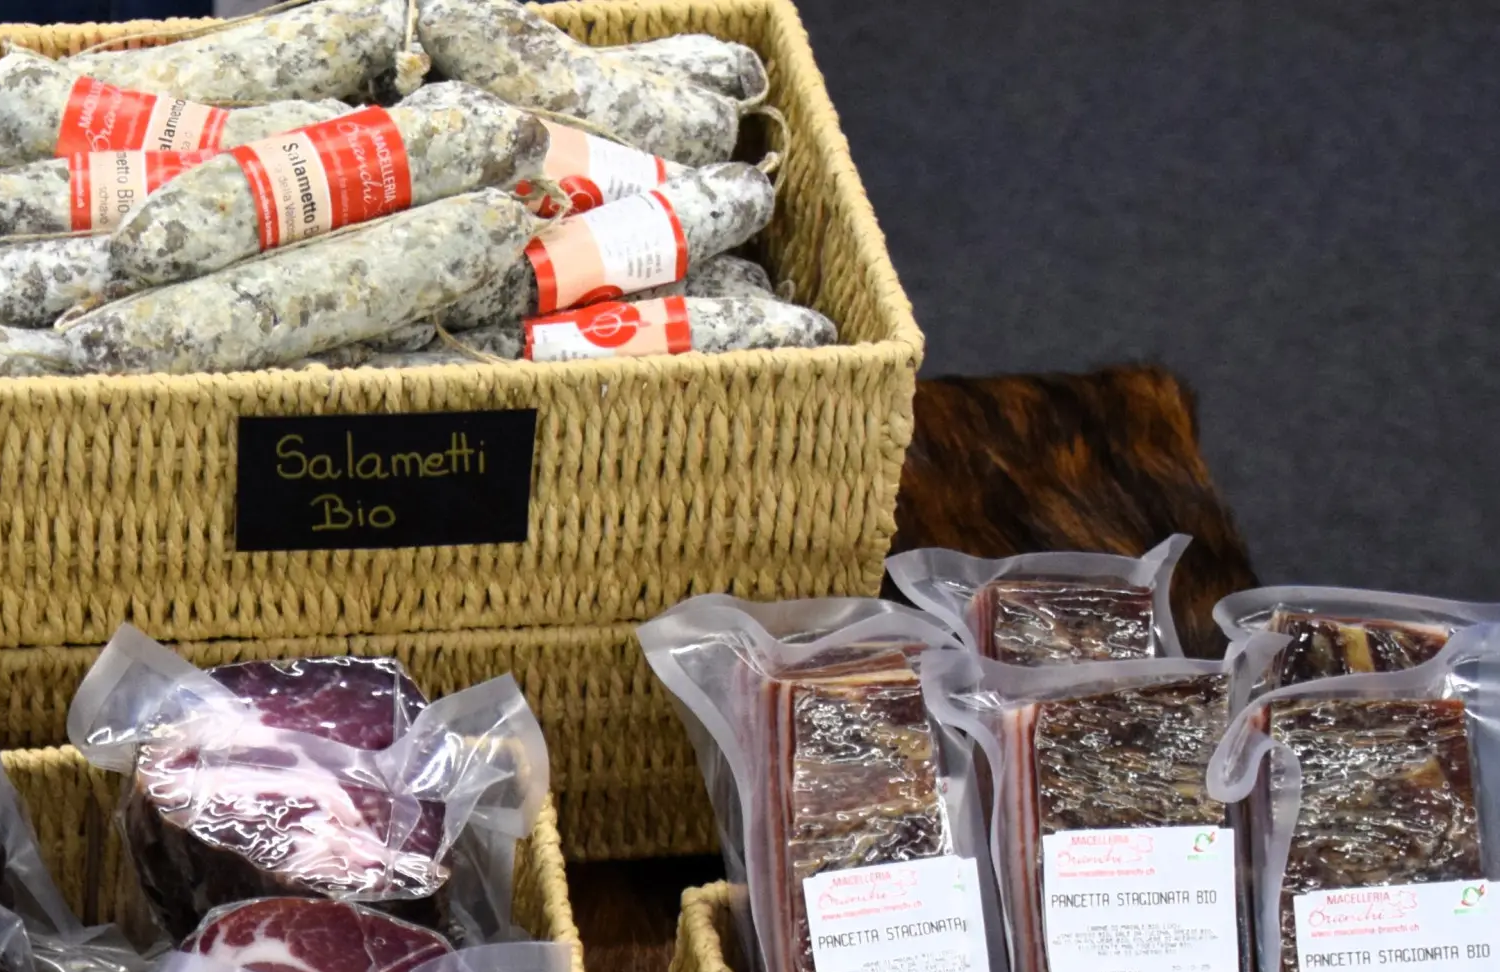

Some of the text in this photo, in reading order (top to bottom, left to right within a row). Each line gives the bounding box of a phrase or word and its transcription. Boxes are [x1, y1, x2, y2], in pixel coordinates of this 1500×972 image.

[159, 99, 187, 151] alametto
[282, 142, 317, 225] Salametto
[370, 128, 397, 203] MACELLERIA
[275, 430, 487, 480] Salametti
[310, 493, 397, 532] Bio
[1051, 889, 1218, 909] PANCETTA STAGIONATA BIO
[1326, 891, 1392, 906] MACELLERIA
[818, 916, 963, 950] PANCETTA STAGIONATA
[1305, 943, 1491, 969] PANCETTA STAGIONATA BIO
